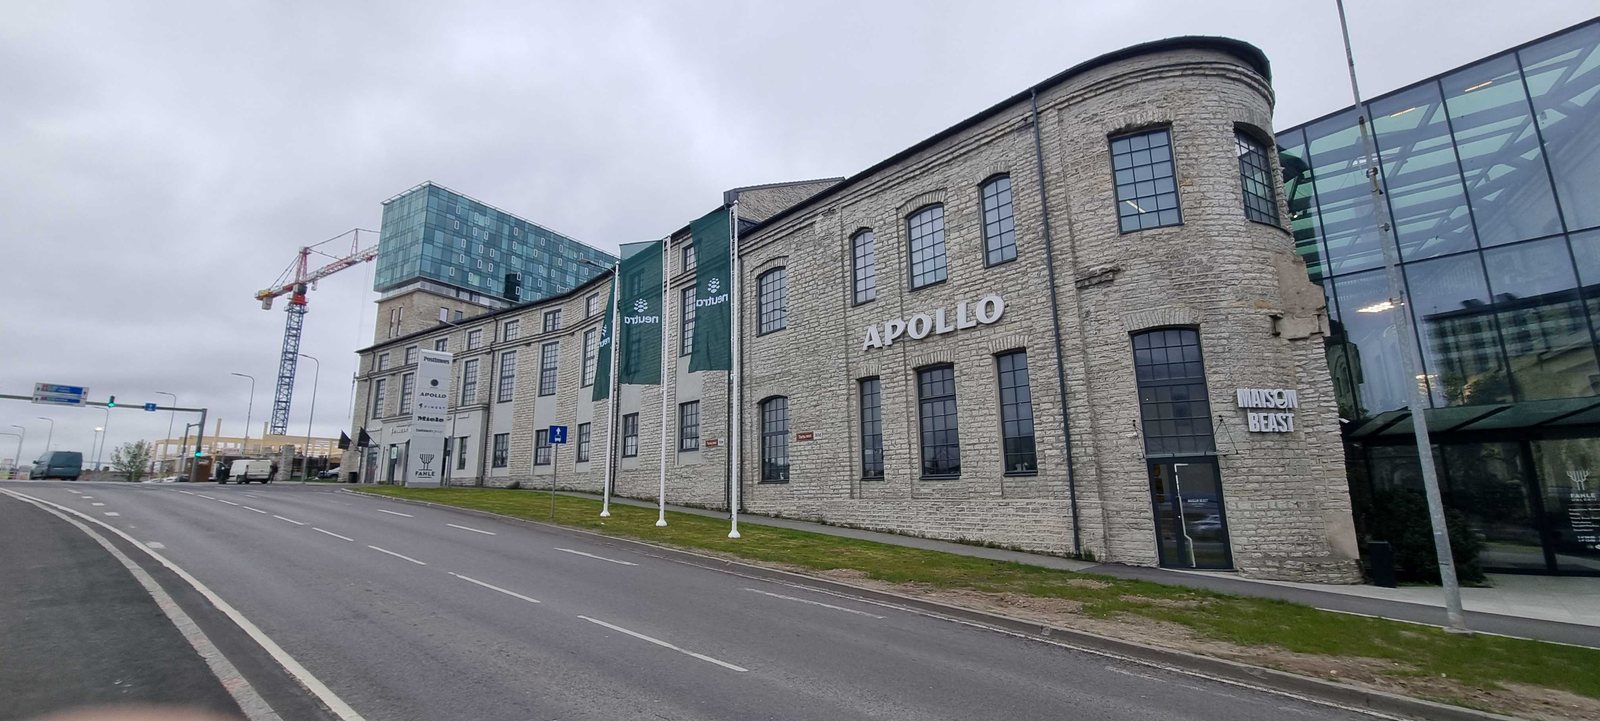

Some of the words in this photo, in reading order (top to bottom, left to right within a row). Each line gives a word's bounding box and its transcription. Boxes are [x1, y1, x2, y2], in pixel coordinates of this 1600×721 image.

[862, 294, 1006, 351] APOLLO
[1236, 388, 1298, 409] MAISON
[1248, 412, 1295, 432] BEAST
